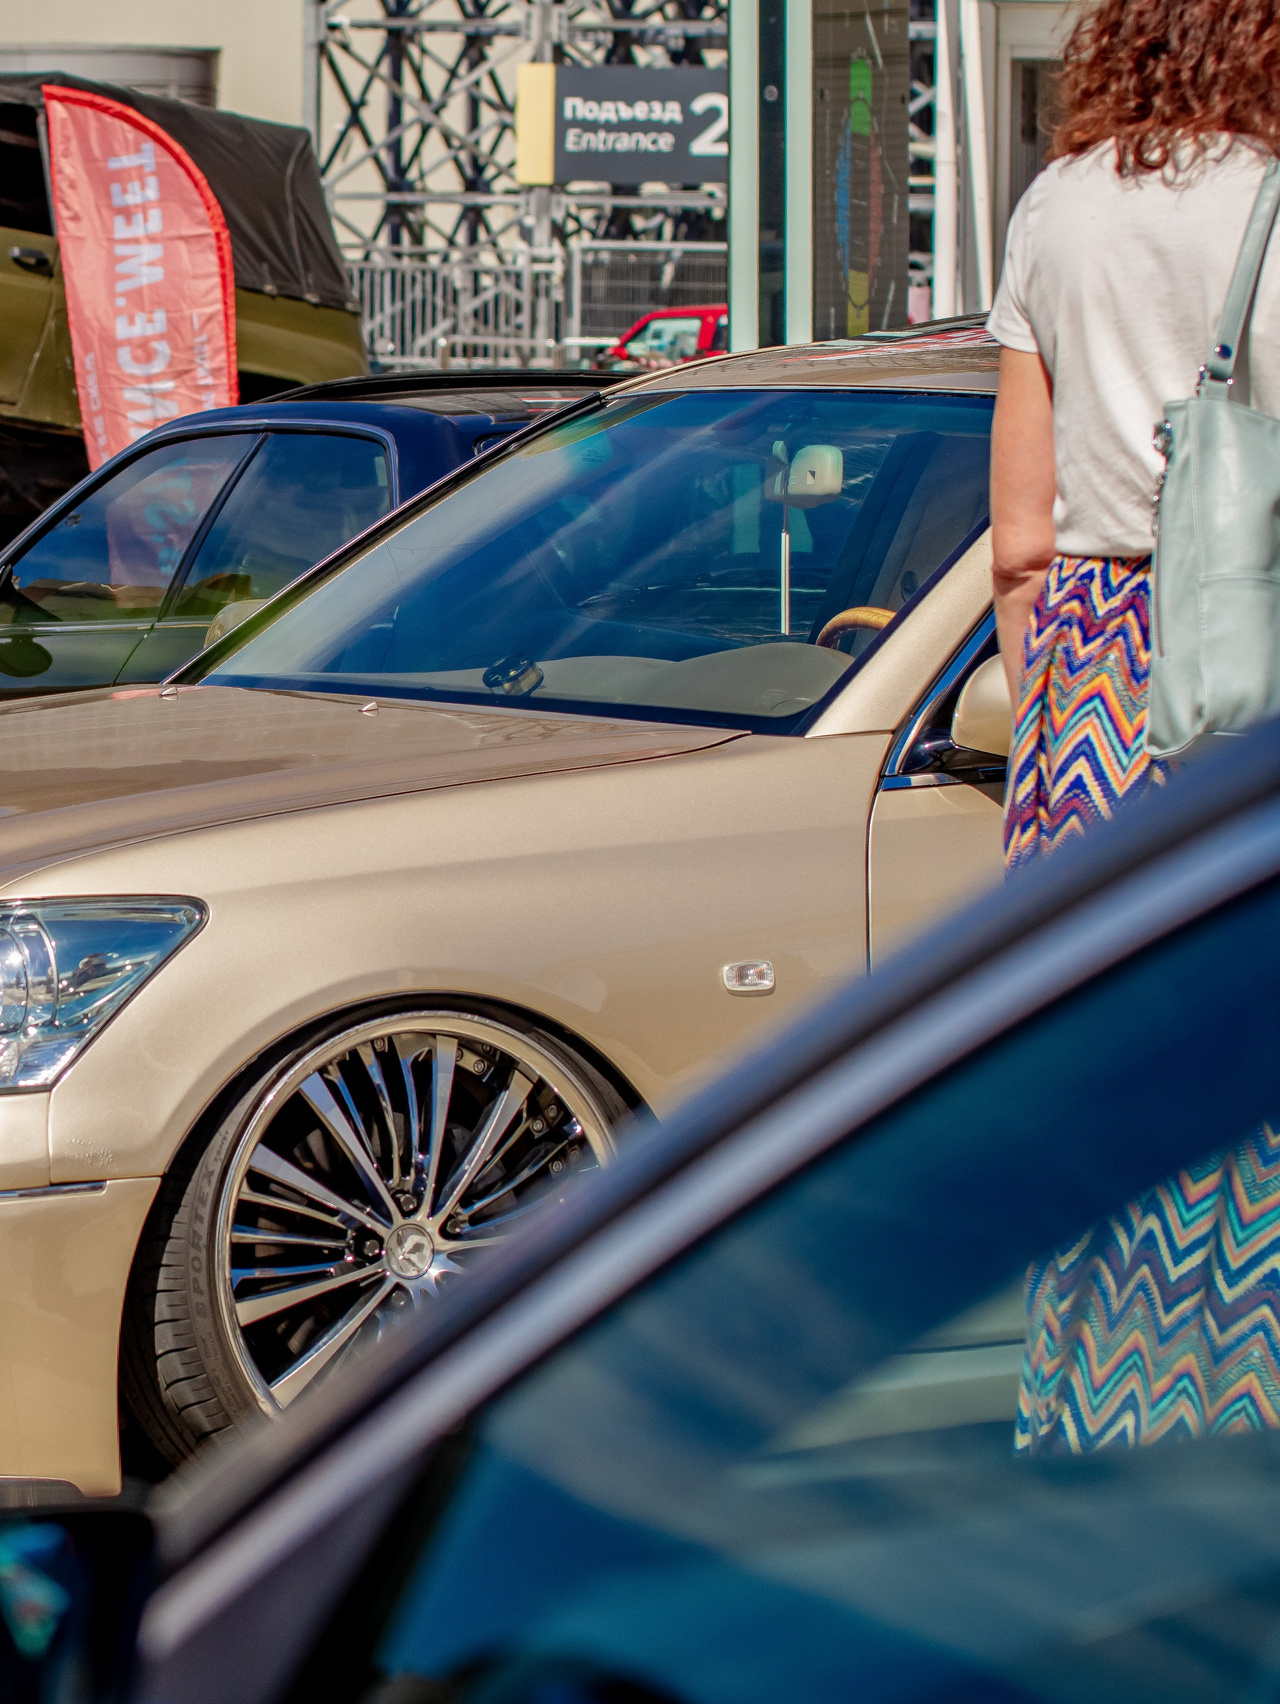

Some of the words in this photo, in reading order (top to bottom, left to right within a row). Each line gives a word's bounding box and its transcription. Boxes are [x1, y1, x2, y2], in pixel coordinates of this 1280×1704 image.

[563, 96, 683, 125] Подъезд
[688, 92, 729, 157] 2
[565, 128, 676, 153] Entrance
